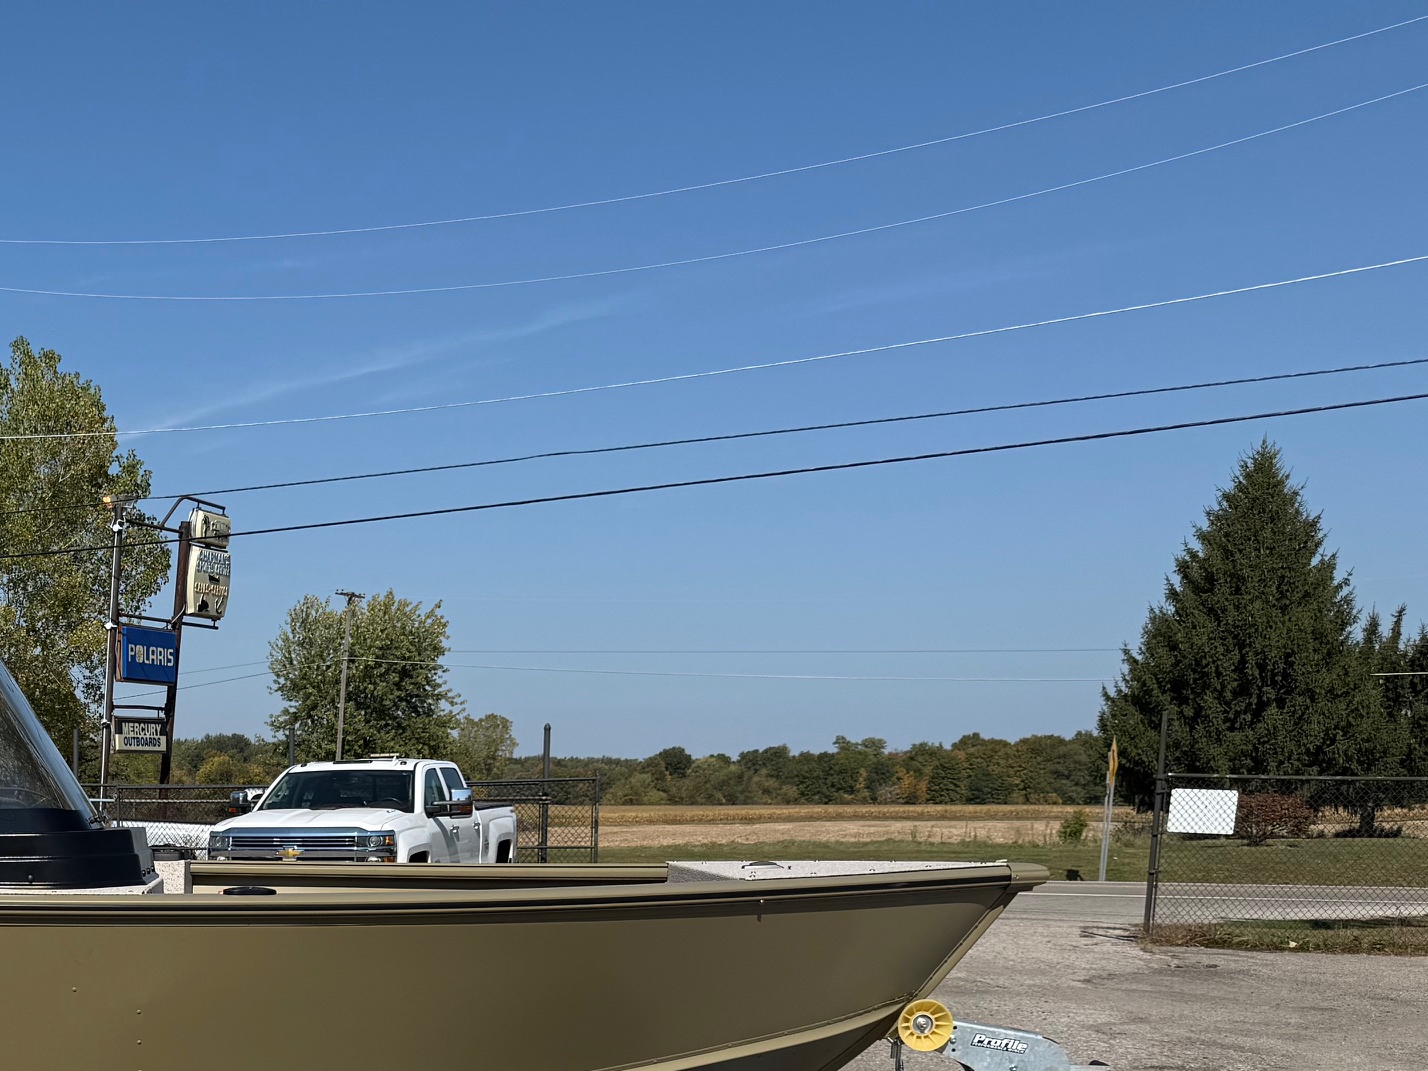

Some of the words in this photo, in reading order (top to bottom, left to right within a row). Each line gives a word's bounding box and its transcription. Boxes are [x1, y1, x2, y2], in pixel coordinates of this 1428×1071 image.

[128, 643, 174, 667] POLARIS
[122, 722, 162, 736] MERCURY
[123, 736, 161, 748] OUTBOARDS
[973, 1033, 1028, 1051] Profile
